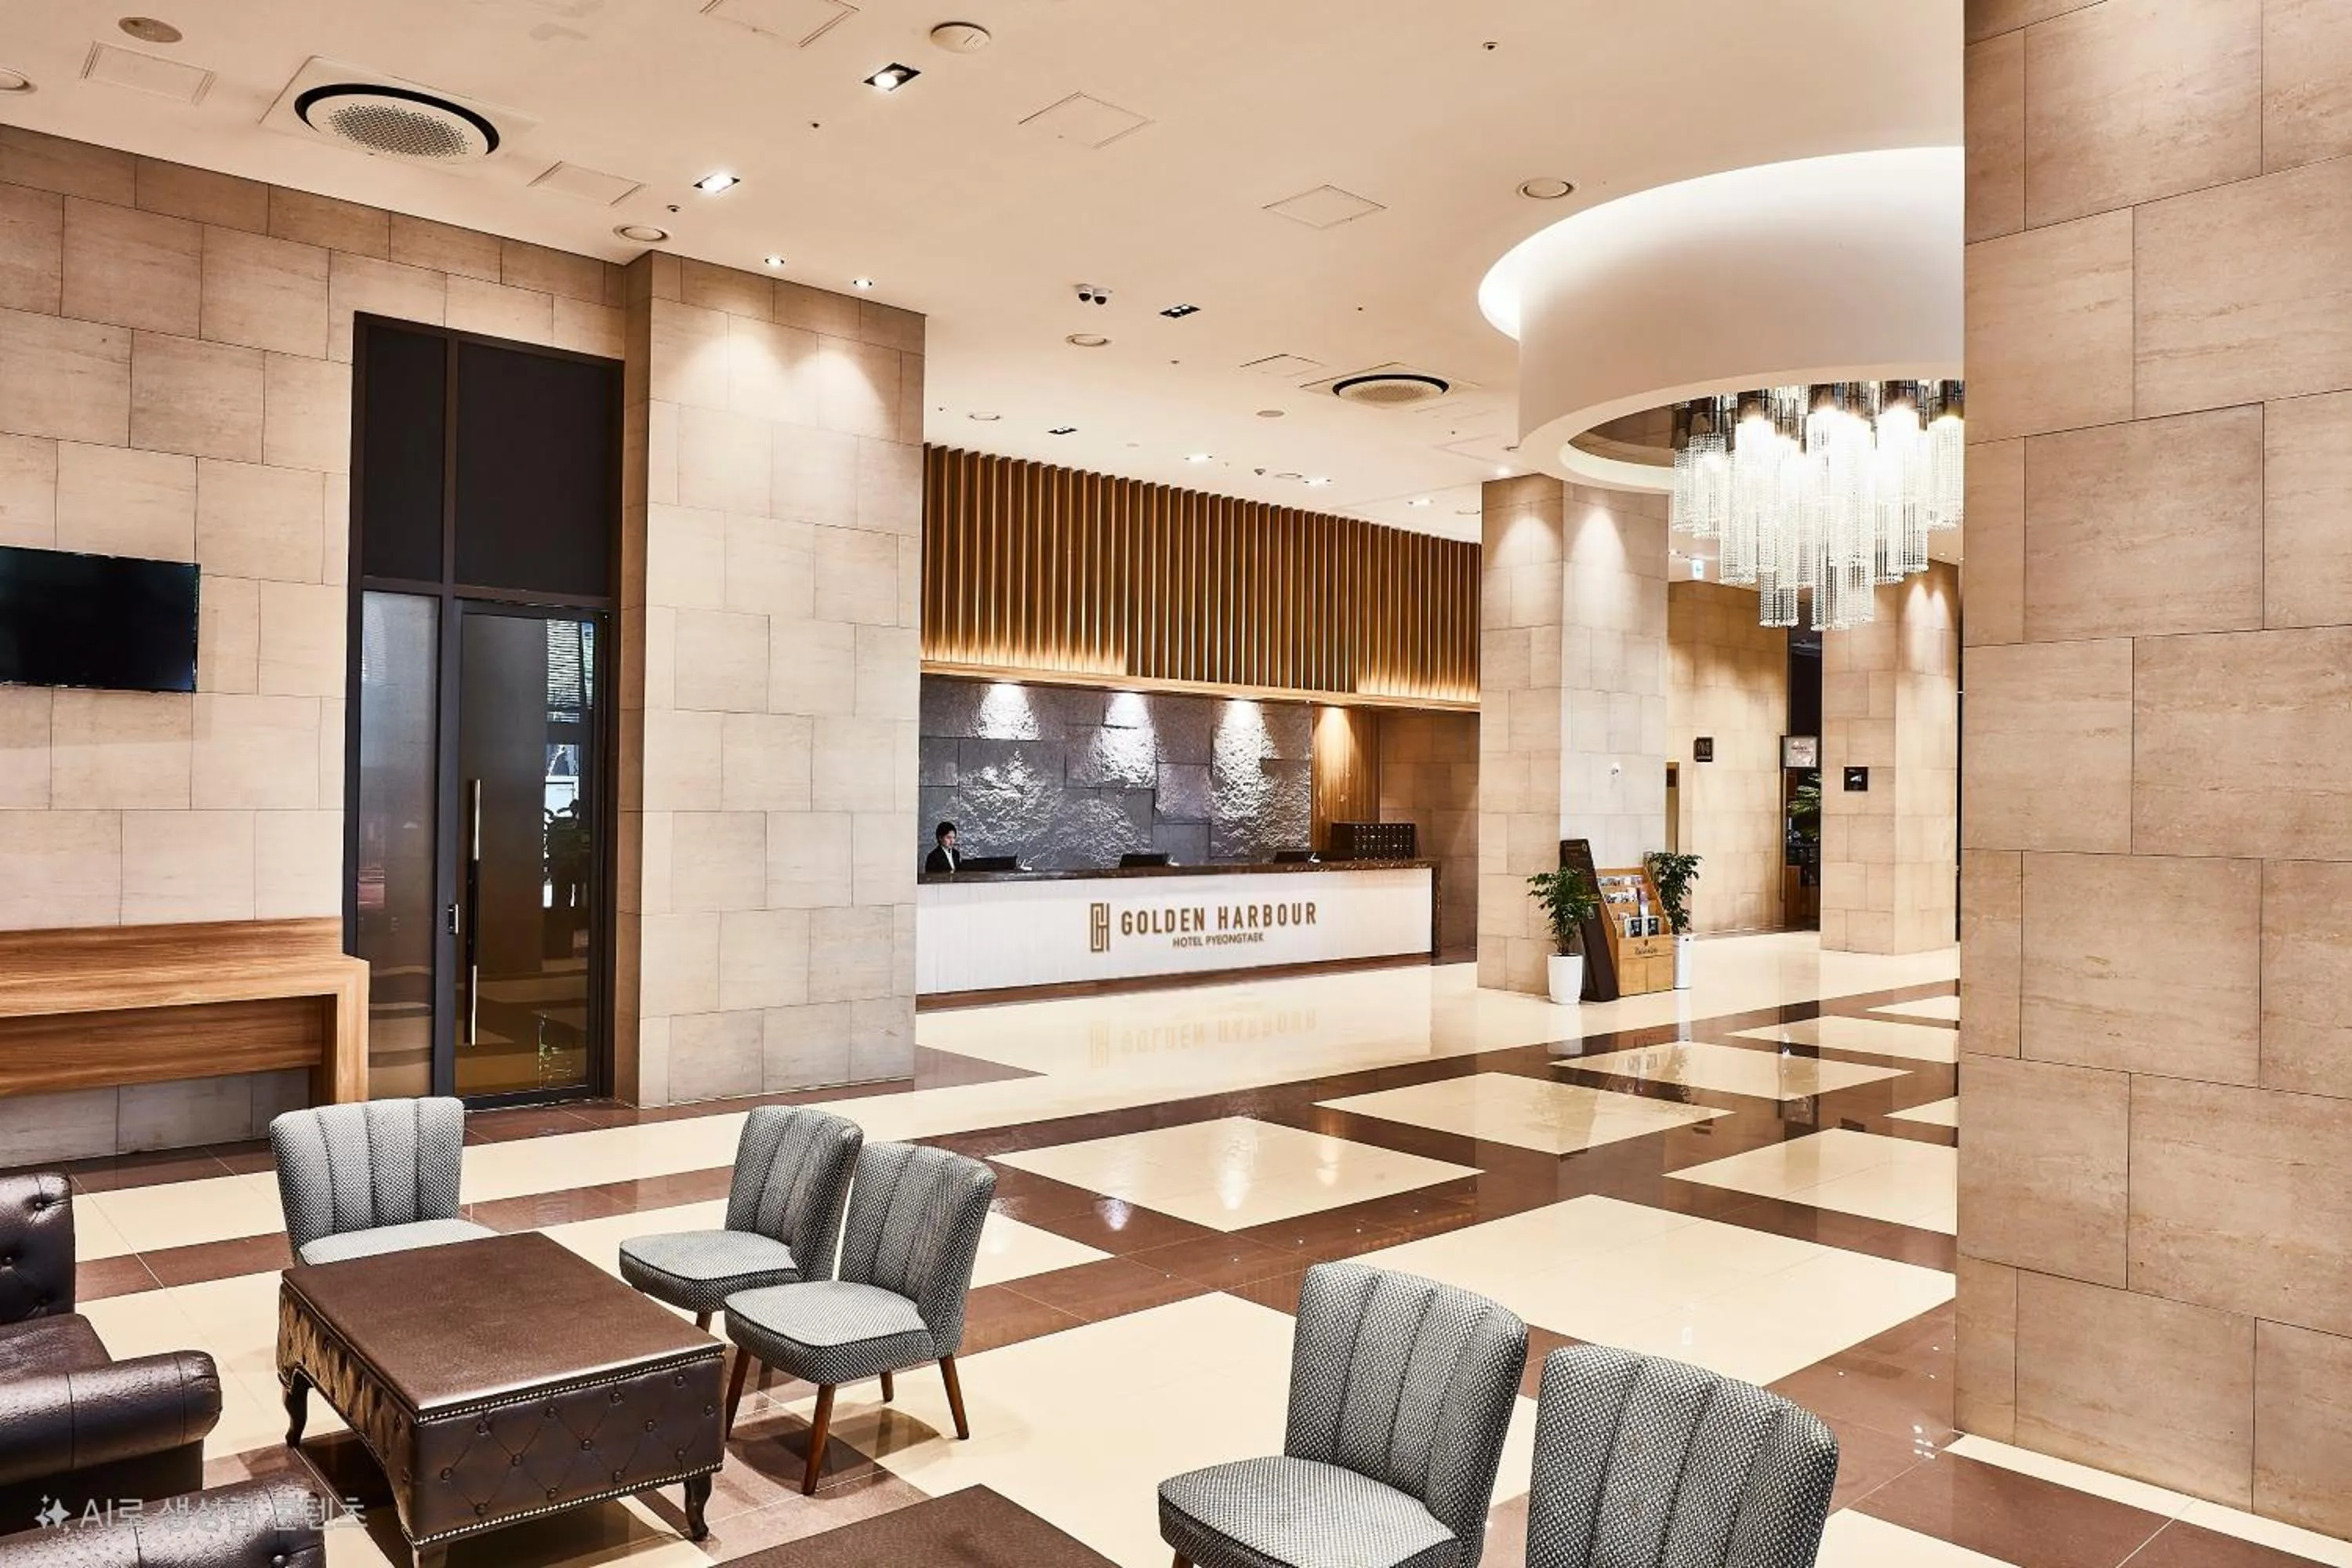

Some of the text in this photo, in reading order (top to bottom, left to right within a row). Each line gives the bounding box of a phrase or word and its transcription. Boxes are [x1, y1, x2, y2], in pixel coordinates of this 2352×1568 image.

[1121, 902, 1316, 935] GOLDEN HARBOUR
[1172, 932, 1264, 948] HOTEL PYEONGTAEK
